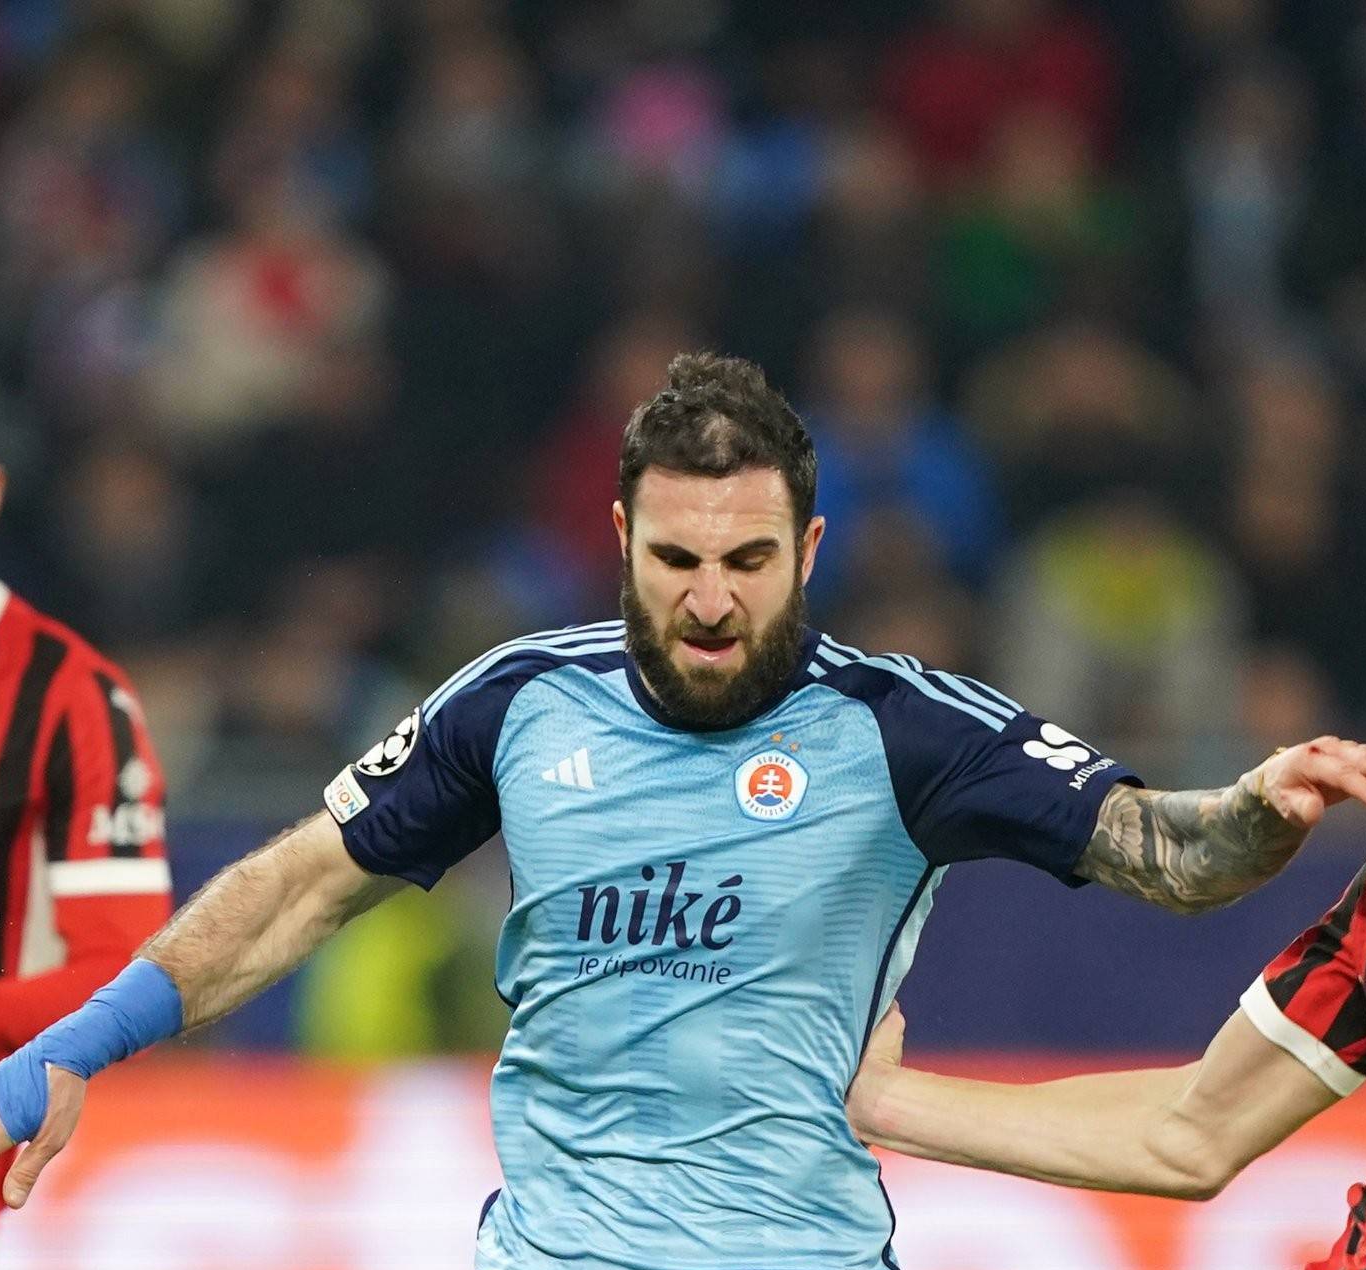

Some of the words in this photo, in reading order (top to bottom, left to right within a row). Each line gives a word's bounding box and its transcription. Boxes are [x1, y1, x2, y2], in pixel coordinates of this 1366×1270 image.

[576, 861, 743, 951] niké
[573, 956, 600, 980] je
[603, 953, 732, 985] tipovanie
